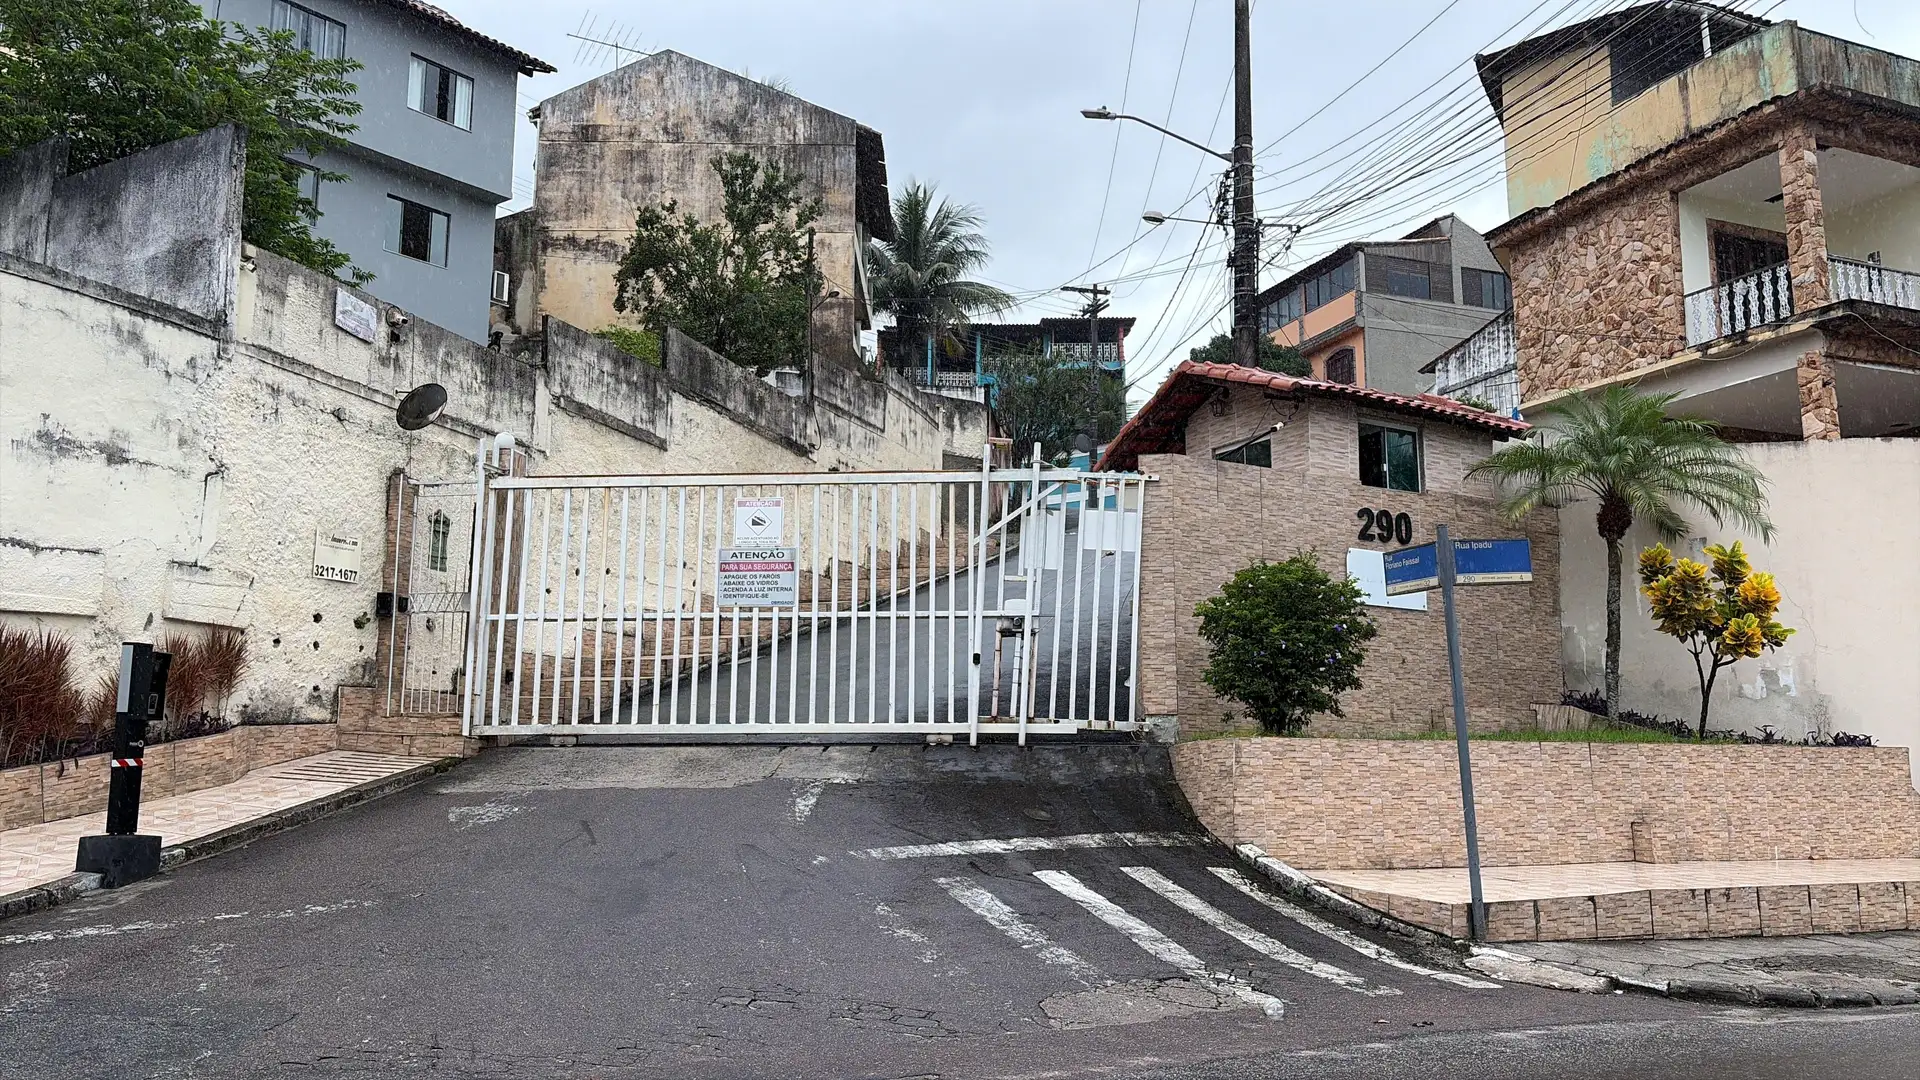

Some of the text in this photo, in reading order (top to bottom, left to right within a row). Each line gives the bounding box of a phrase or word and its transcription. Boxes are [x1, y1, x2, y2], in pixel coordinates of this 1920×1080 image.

[1357, 507, 1412, 545] 290
[1455, 541, 1492, 550] Rua Ipadu
[730, 549, 785, 560] ATENÇÃO
[721, 563, 739, 571] PARA
[740, 563, 753, 571] SUA
[1385, 556, 1420, 570] Floriano Faissal
[314, 564, 358, 581] 3217-1677
[1463, 575, 1476, 583] 290
